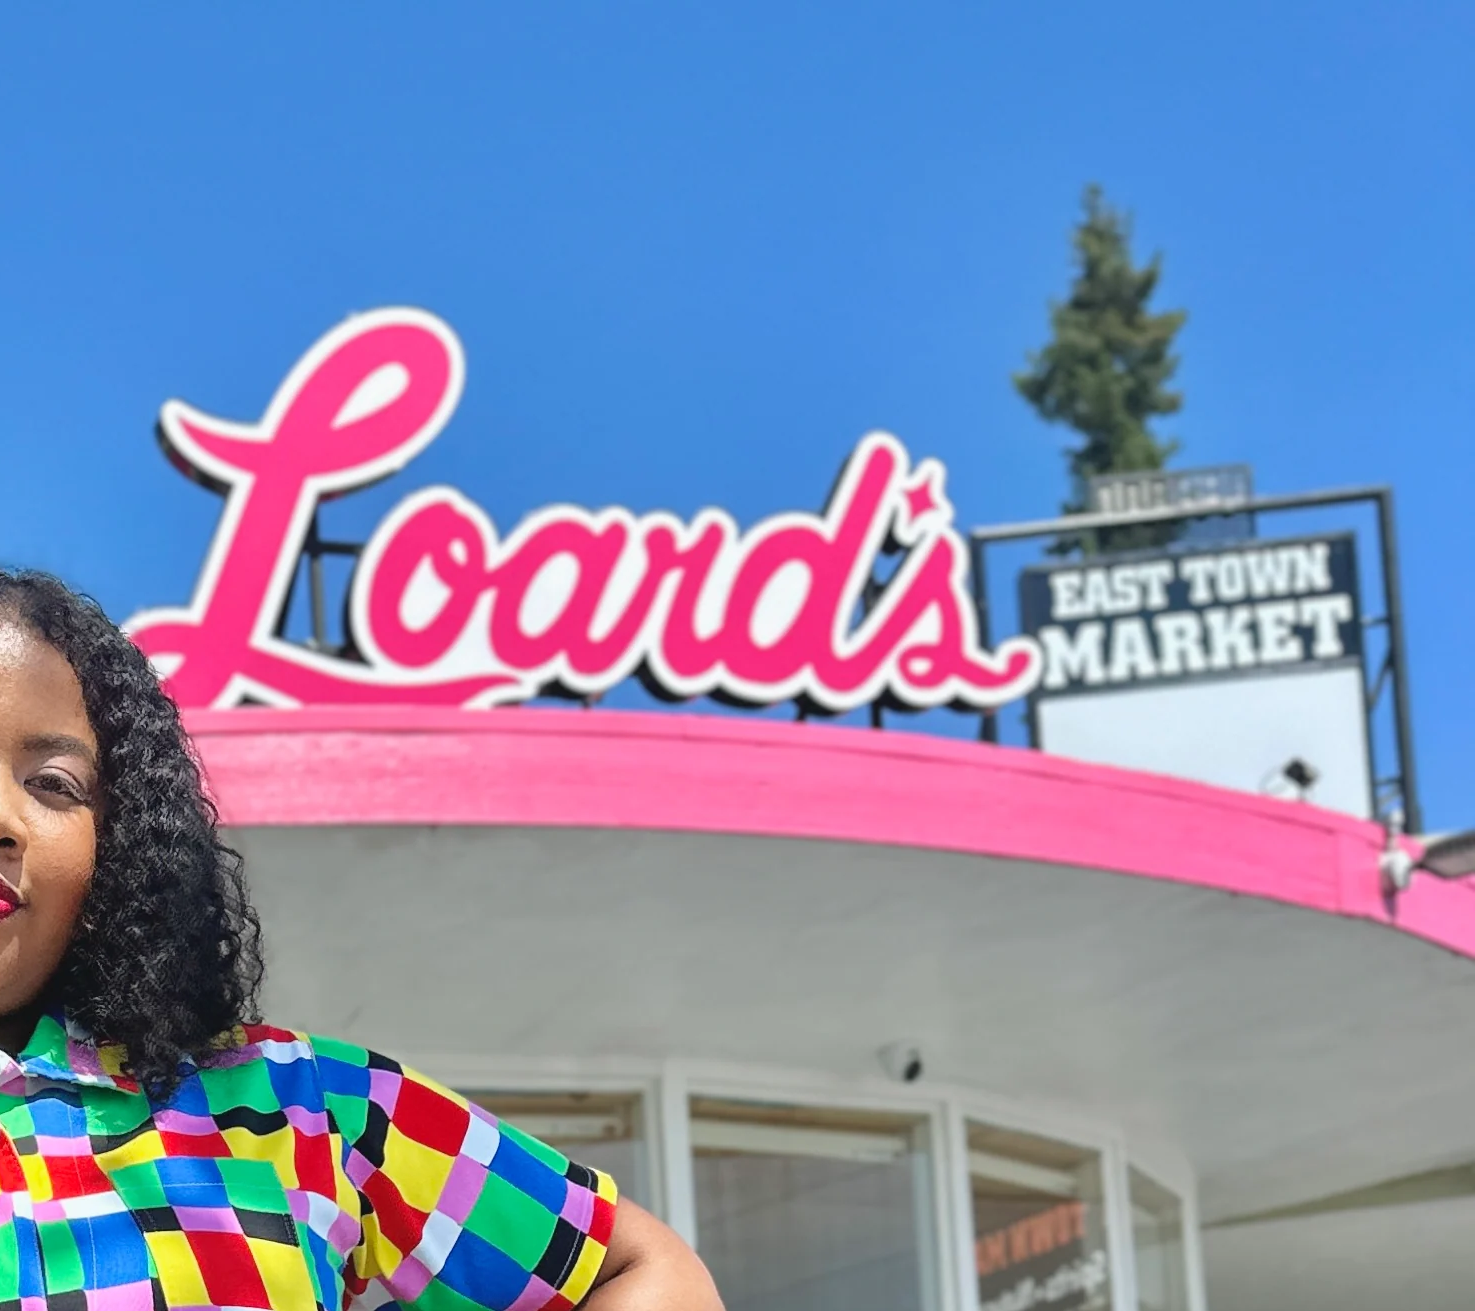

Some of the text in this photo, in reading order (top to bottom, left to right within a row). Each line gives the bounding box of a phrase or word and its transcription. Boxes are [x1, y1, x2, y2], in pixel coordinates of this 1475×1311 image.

[124, 307, 1041, 713] Loard's
[1048, 542, 1332, 622] EAST TOWN
[1037, 593, 1354, 690] MARKET
